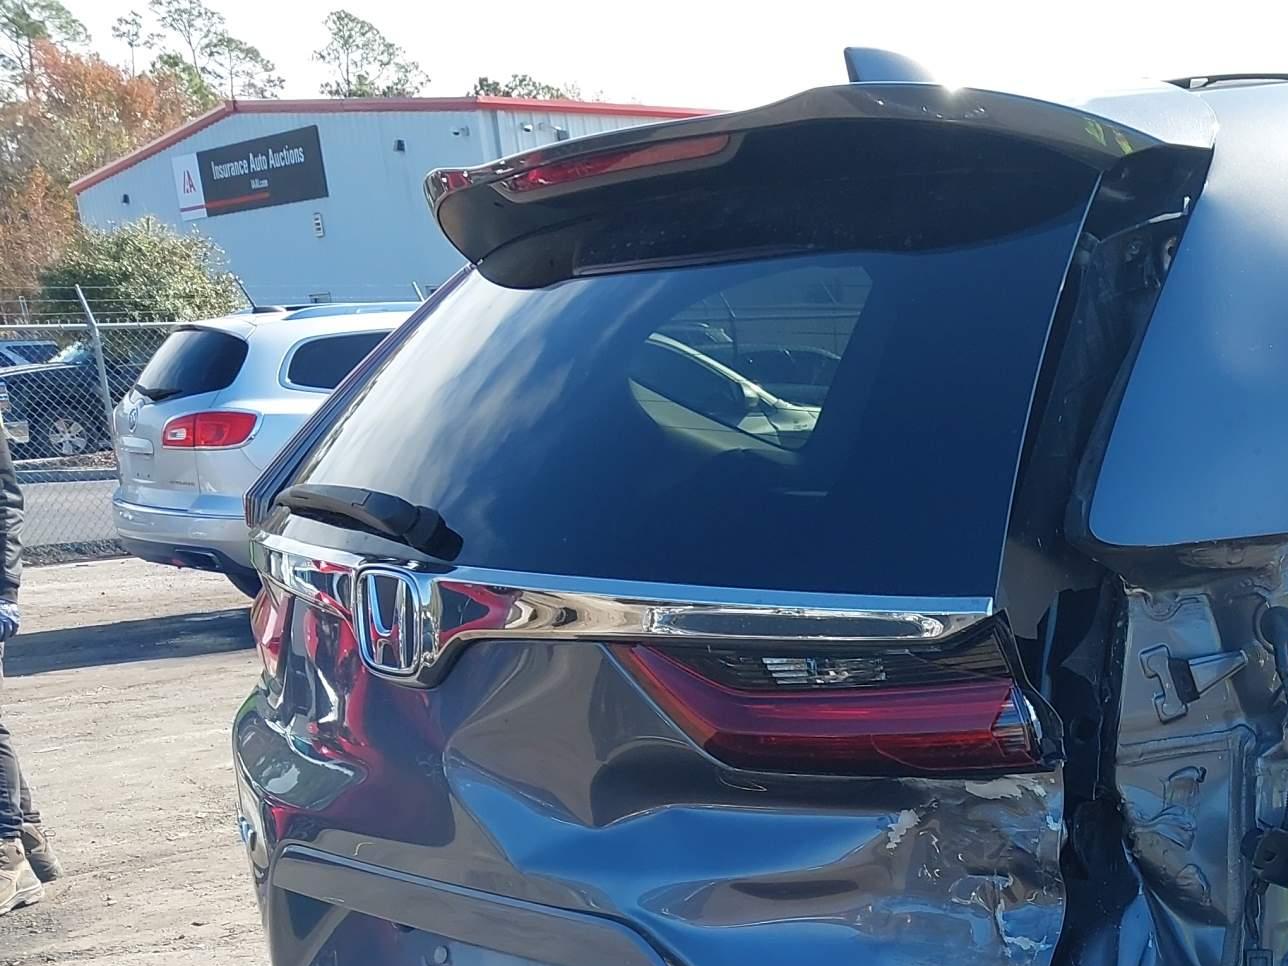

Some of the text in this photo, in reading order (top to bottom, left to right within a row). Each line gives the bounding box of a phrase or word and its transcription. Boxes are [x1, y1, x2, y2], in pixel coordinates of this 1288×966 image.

[211, 144, 305, 180] Insurance Auto Auctions
